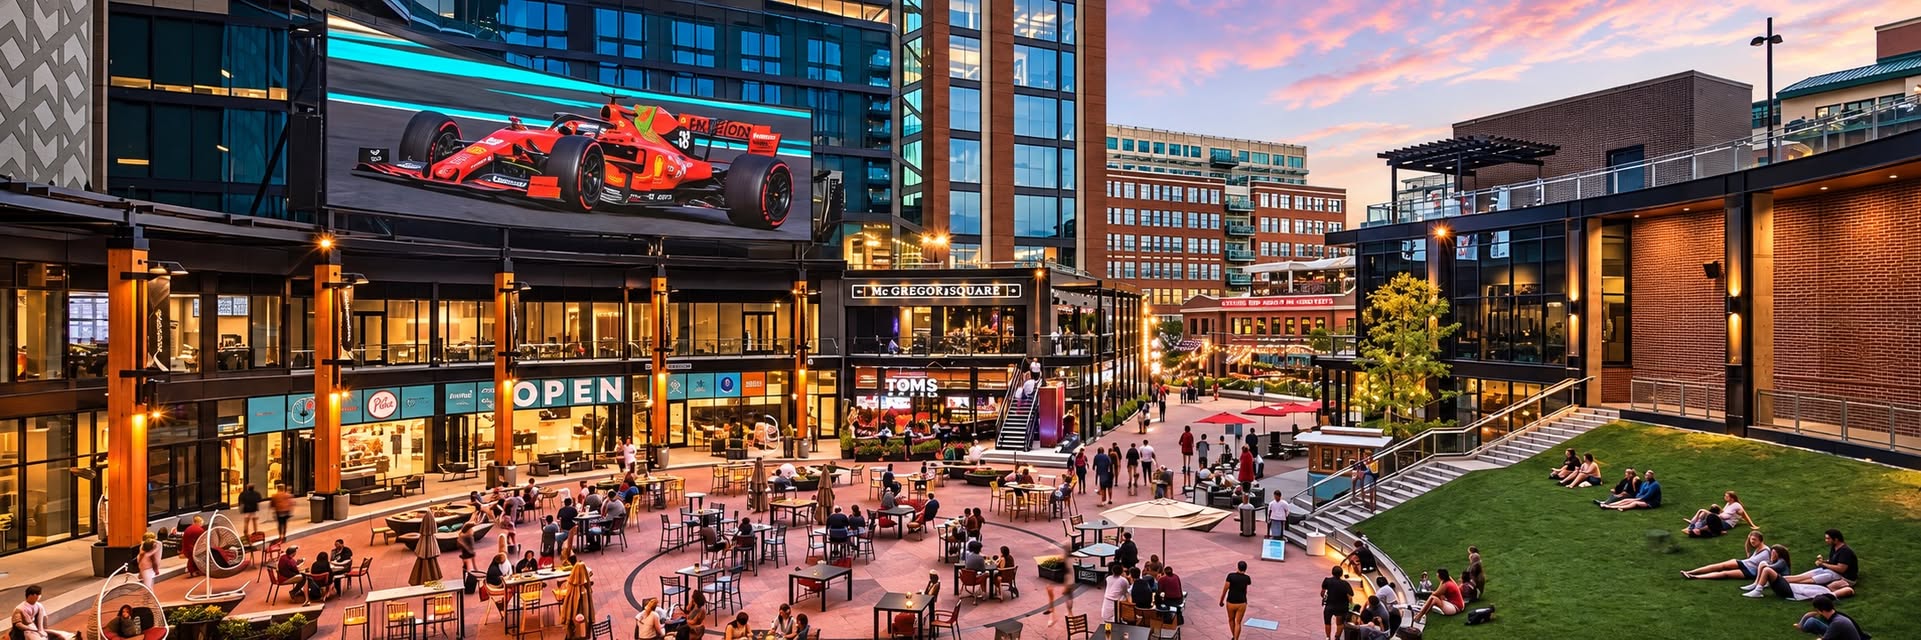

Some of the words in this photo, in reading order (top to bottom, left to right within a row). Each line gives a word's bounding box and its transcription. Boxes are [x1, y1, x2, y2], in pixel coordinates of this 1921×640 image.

[871, 286, 888, 296] Mc
[891, 286, 944, 296] GREGOR
[949, 286, 1000, 297] SQUARE
[513, 376, 623, 407] OPEN
[885, 378, 938, 392] TOMS
